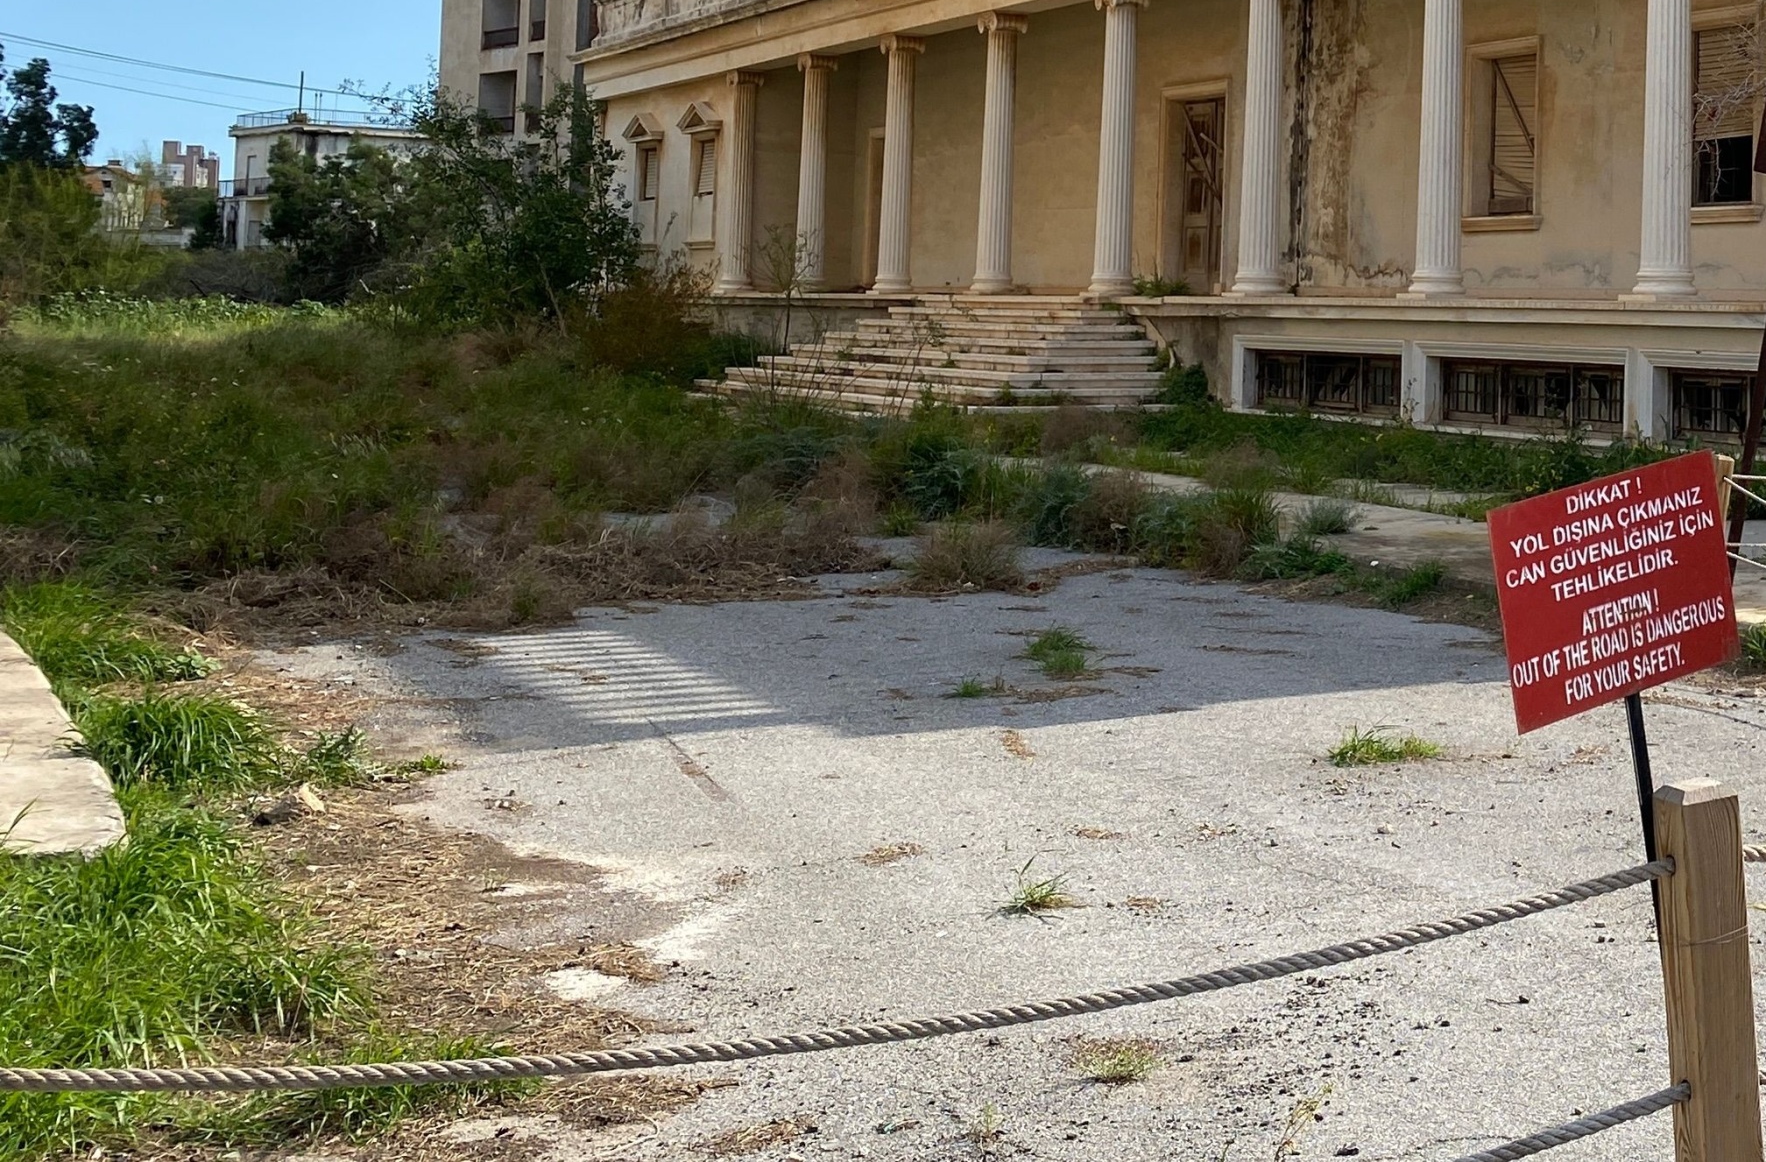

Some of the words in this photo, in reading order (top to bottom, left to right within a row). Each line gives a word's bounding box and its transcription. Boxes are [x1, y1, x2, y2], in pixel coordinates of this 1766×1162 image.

[1510, 534, 1550, 558] YOL
[1553, 514, 1614, 546] DIŞINA
[1618, 487, 1702, 527] ÇIKMANIZ
[1566, 480, 1630, 514] DİKKAT
[1506, 561, 1546, 588] CAN
[1550, 521, 1676, 574] GÜVENLİĞİNİZ
[1680, 510, 1714, 538] İÇİN
[1552, 549, 1678, 601] TEHLİKELİDİR.
[1513, 658, 1539, 688] OUT
[1543, 650, 1560, 678] OF
[1563, 640, 1590, 670] THE
[1592, 629, 1628, 662] ROAD
[1632, 621, 1644, 648] IS
[1648, 596, 1725, 644] DANGEROUS
[1583, 594, 1652, 636] ATTENTION
[1565, 678, 1594, 704] FOR
[1594, 665, 1630, 692] YOUR
[1634, 642, 1684, 680] SAFETY.
